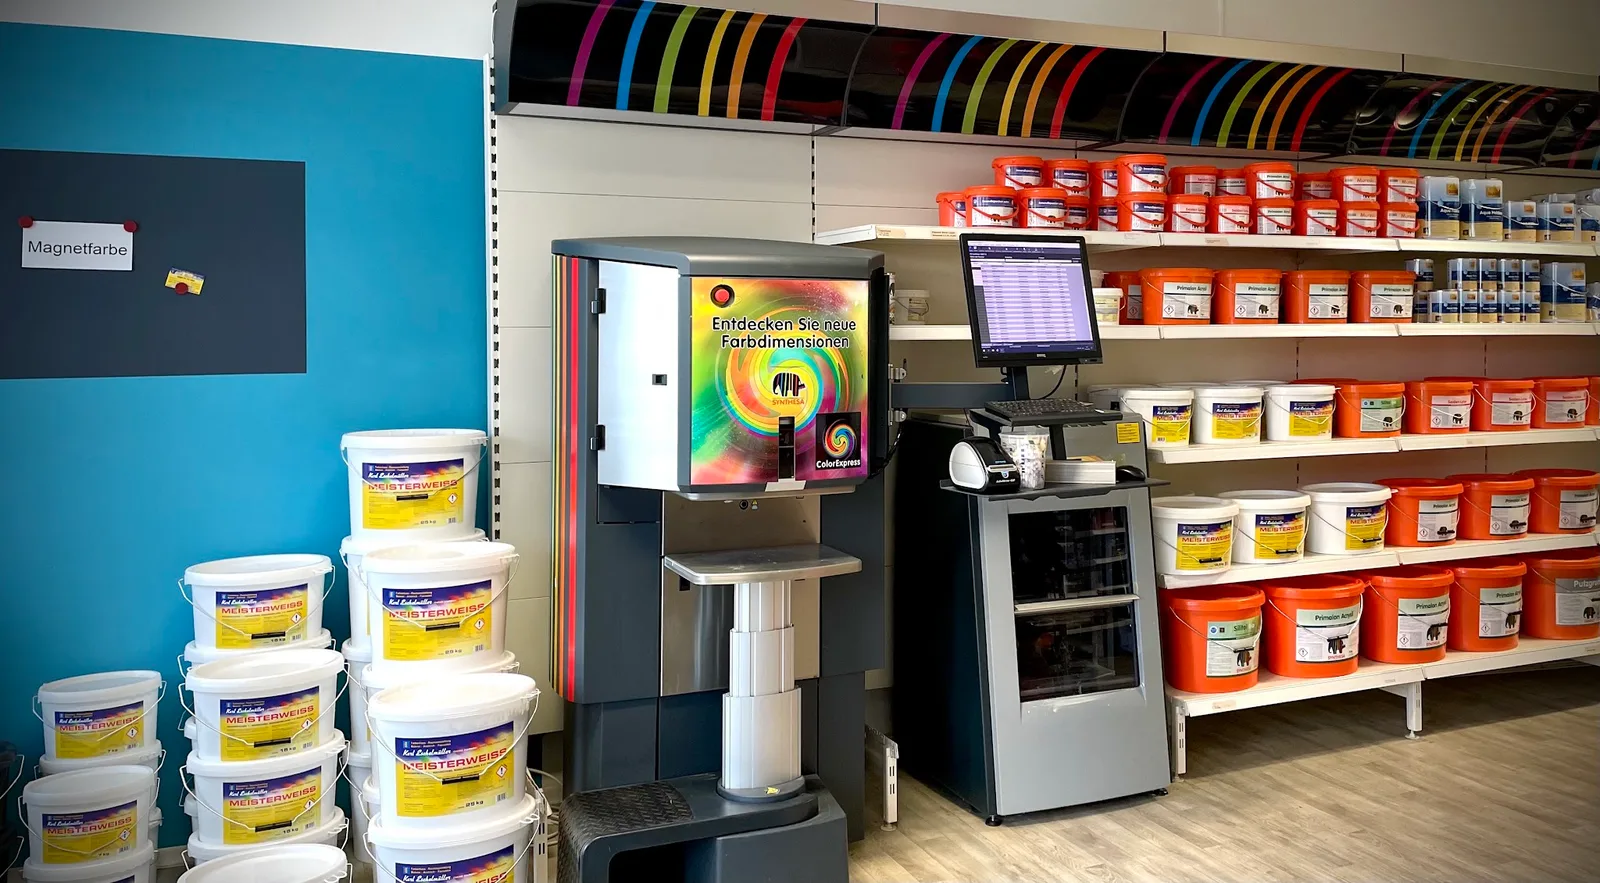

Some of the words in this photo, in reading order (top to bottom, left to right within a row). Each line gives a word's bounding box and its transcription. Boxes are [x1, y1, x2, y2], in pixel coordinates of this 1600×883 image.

[28, 241, 128, 256] Magnetfarbe
[712, 317, 793, 331] Entdecken
[798, 317, 820, 331] Sie
[824, 320, 857, 331] neue
[721, 334, 849, 348] Farbdimensionen
[816, 459, 861, 468] ColorExpress
[368, 479, 458, 490] MEISTERWEISS
[221, 600, 303, 614] MEISTERWEISS
[389, 603, 485, 619] MEISTERWEISS
[226, 705, 314, 724] MEISTERWEISS
[403, 747, 507, 770] MEISTERWEISS
[229, 785, 317, 807] MEISTERWEISS
[47, 817, 132, 834] MEISTERWEISS
